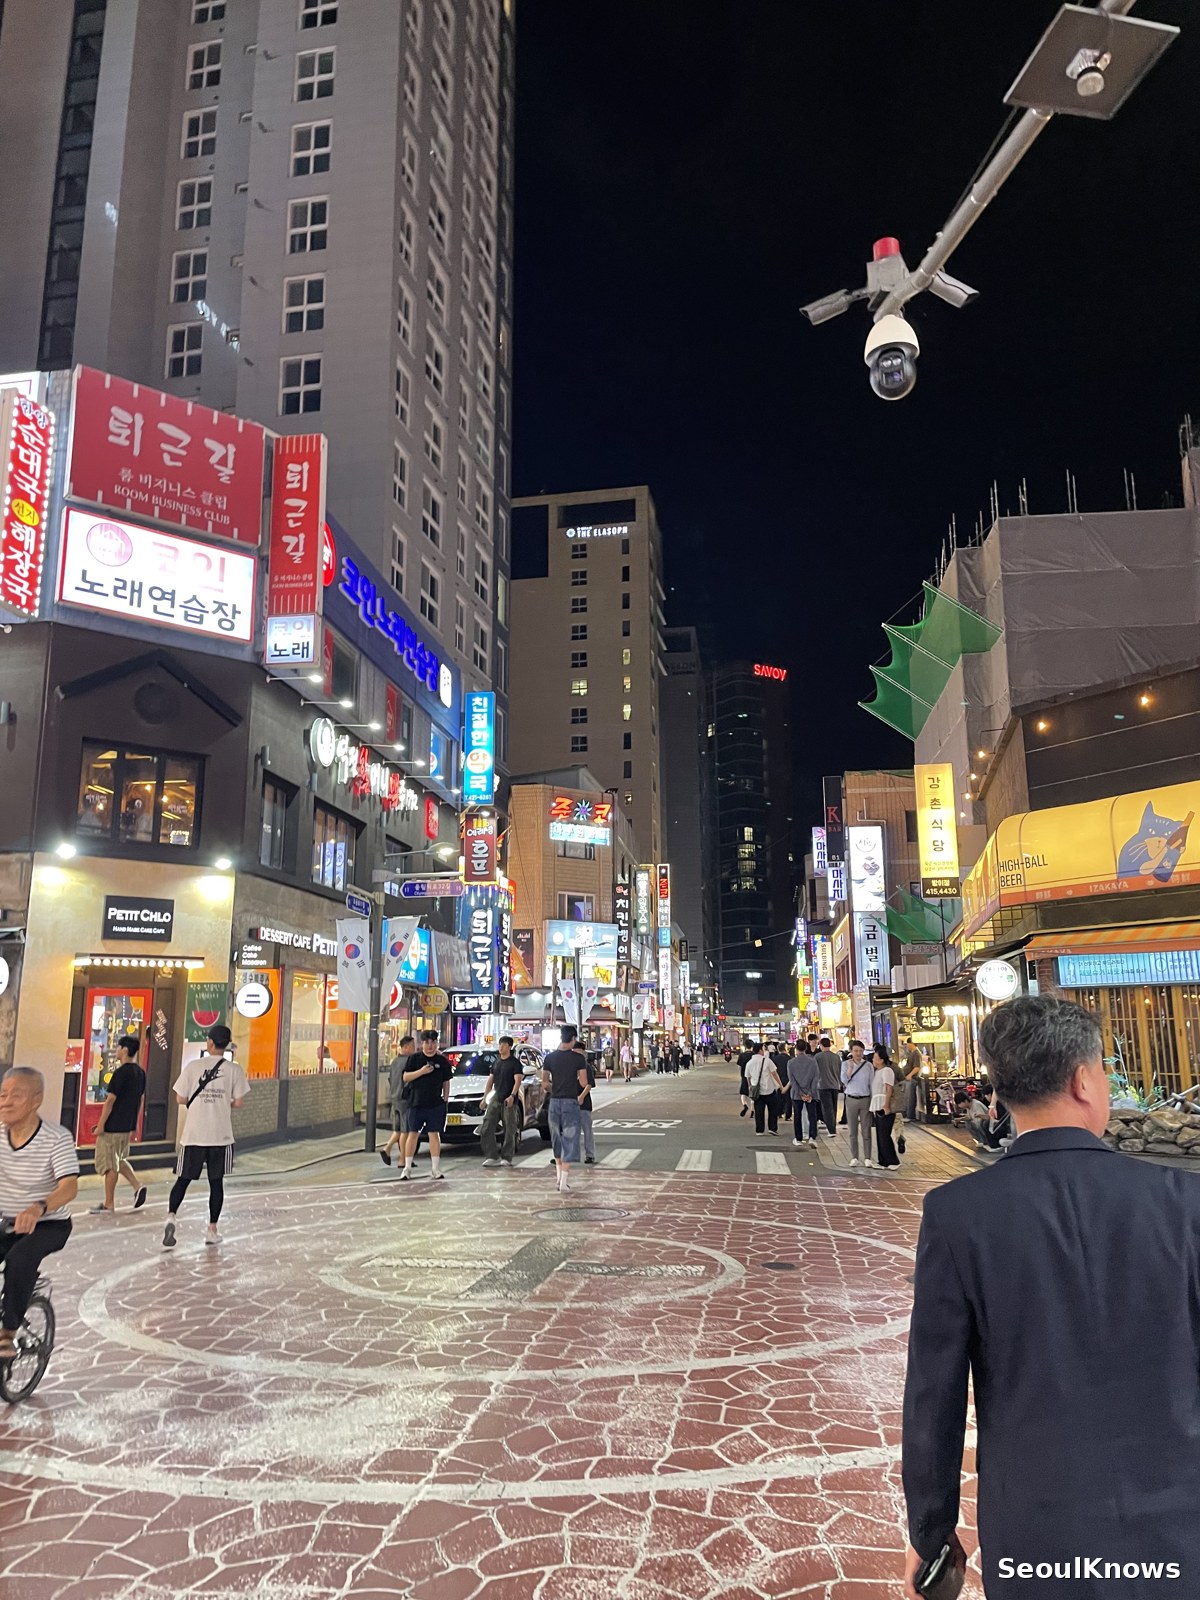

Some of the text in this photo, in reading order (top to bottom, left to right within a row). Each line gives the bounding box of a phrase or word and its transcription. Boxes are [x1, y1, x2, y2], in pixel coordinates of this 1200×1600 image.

[108, 405, 236, 484] 퇴근길
[114, 484, 231, 526] ROOM BUSINESS CLUB
[281, 461, 310, 564] 퇴근길
[74, 568, 242, 632] 노래연습장
[270, 641, 310, 659] 노래
[754, 664, 787, 682] SAVOY
[826, 806, 841, 823] K
[927, 777, 944, 852] 강촌식당
[999, 854, 1048, 873] HIGH-BALL
[832, 869, 844, 899] 마사지
[1000, 874, 1022, 888] BEER
[1089, 880, 1129, 894] IZAKAYA
[140, 909, 172, 922] CHLO
[260, 926, 293, 946] DESSERT
[293, 934, 312, 950] CAFE
[471, 907, 493, 988] 퇴근길
[242, 944, 262, 952] Coffee
[864, 924, 880, 985] 금별맥
[454, 996, 492, 1011] 노래방
[921, 1016, 941, 1028] 식당
